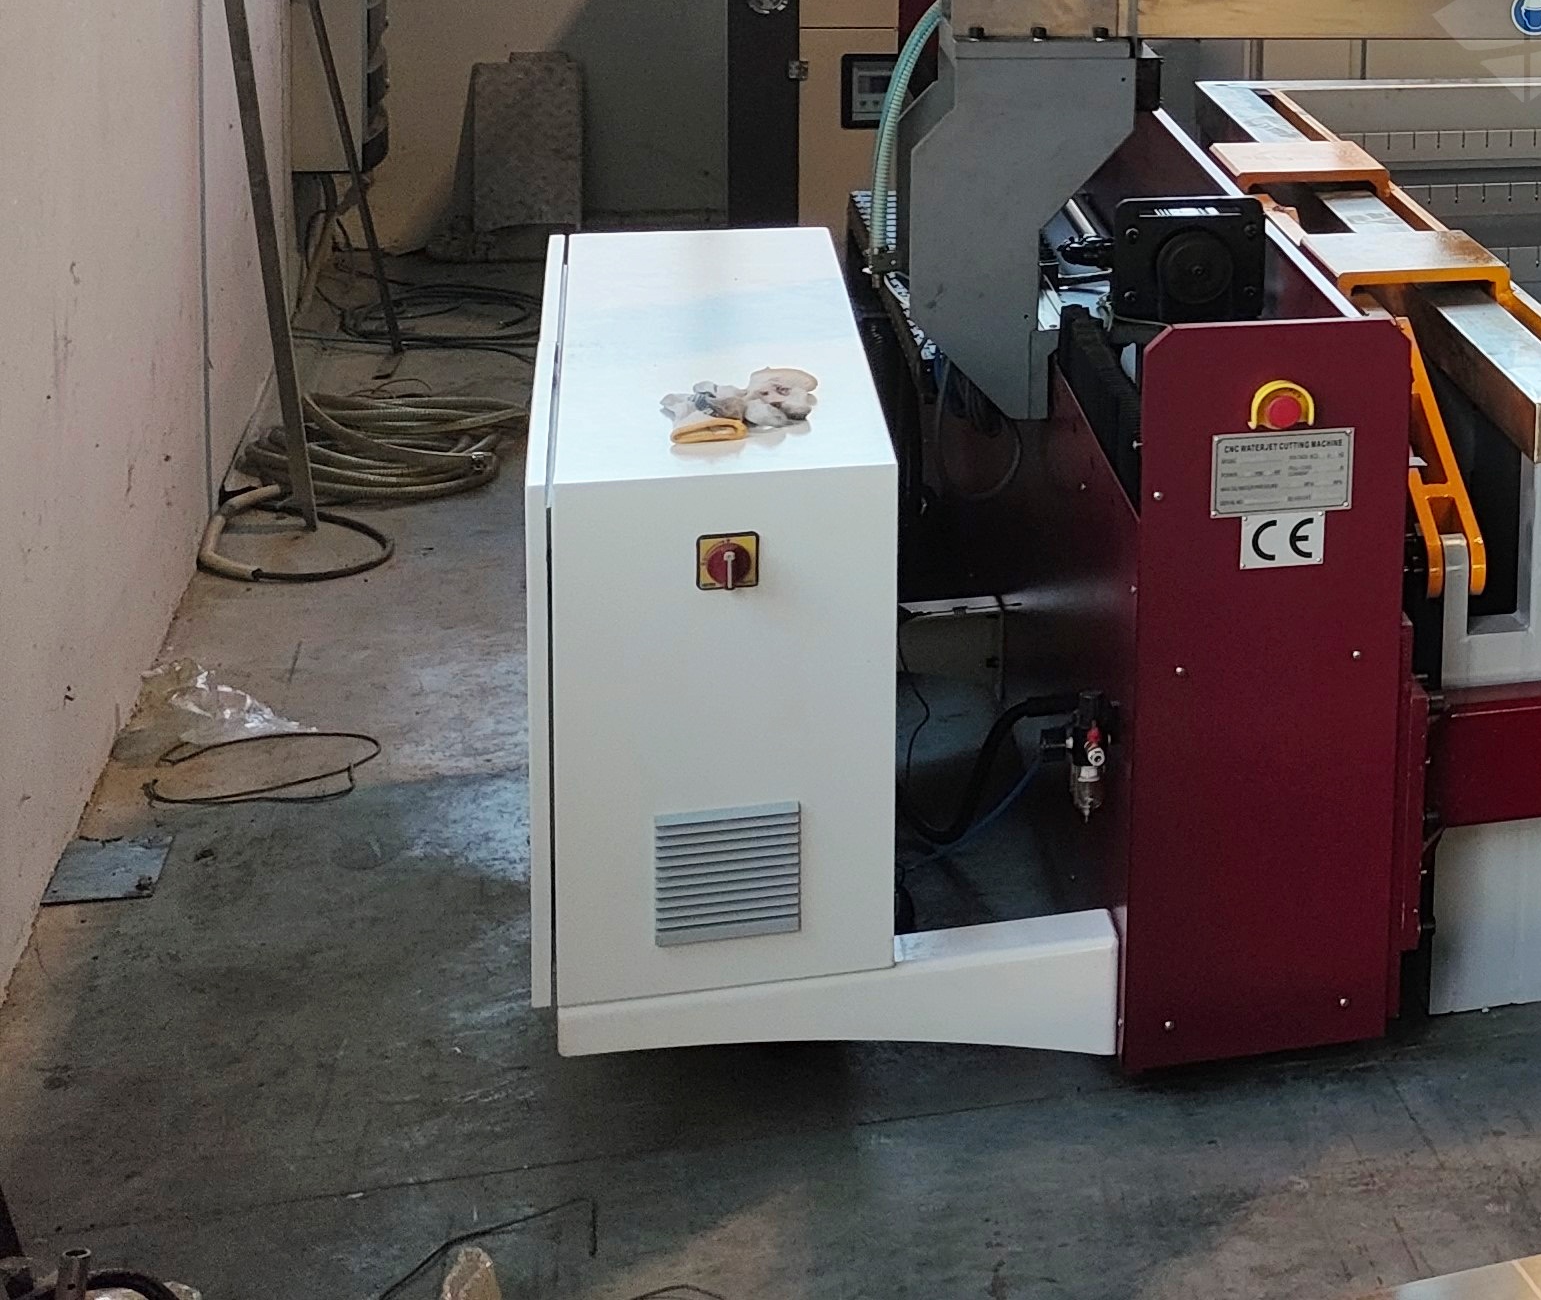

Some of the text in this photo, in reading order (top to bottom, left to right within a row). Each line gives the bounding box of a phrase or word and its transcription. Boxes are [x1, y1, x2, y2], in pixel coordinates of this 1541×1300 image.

[1224, 439, 1343, 453] CNC WATERJET CUTTING MACHINE
[1251, 517, 1314, 561] CE
